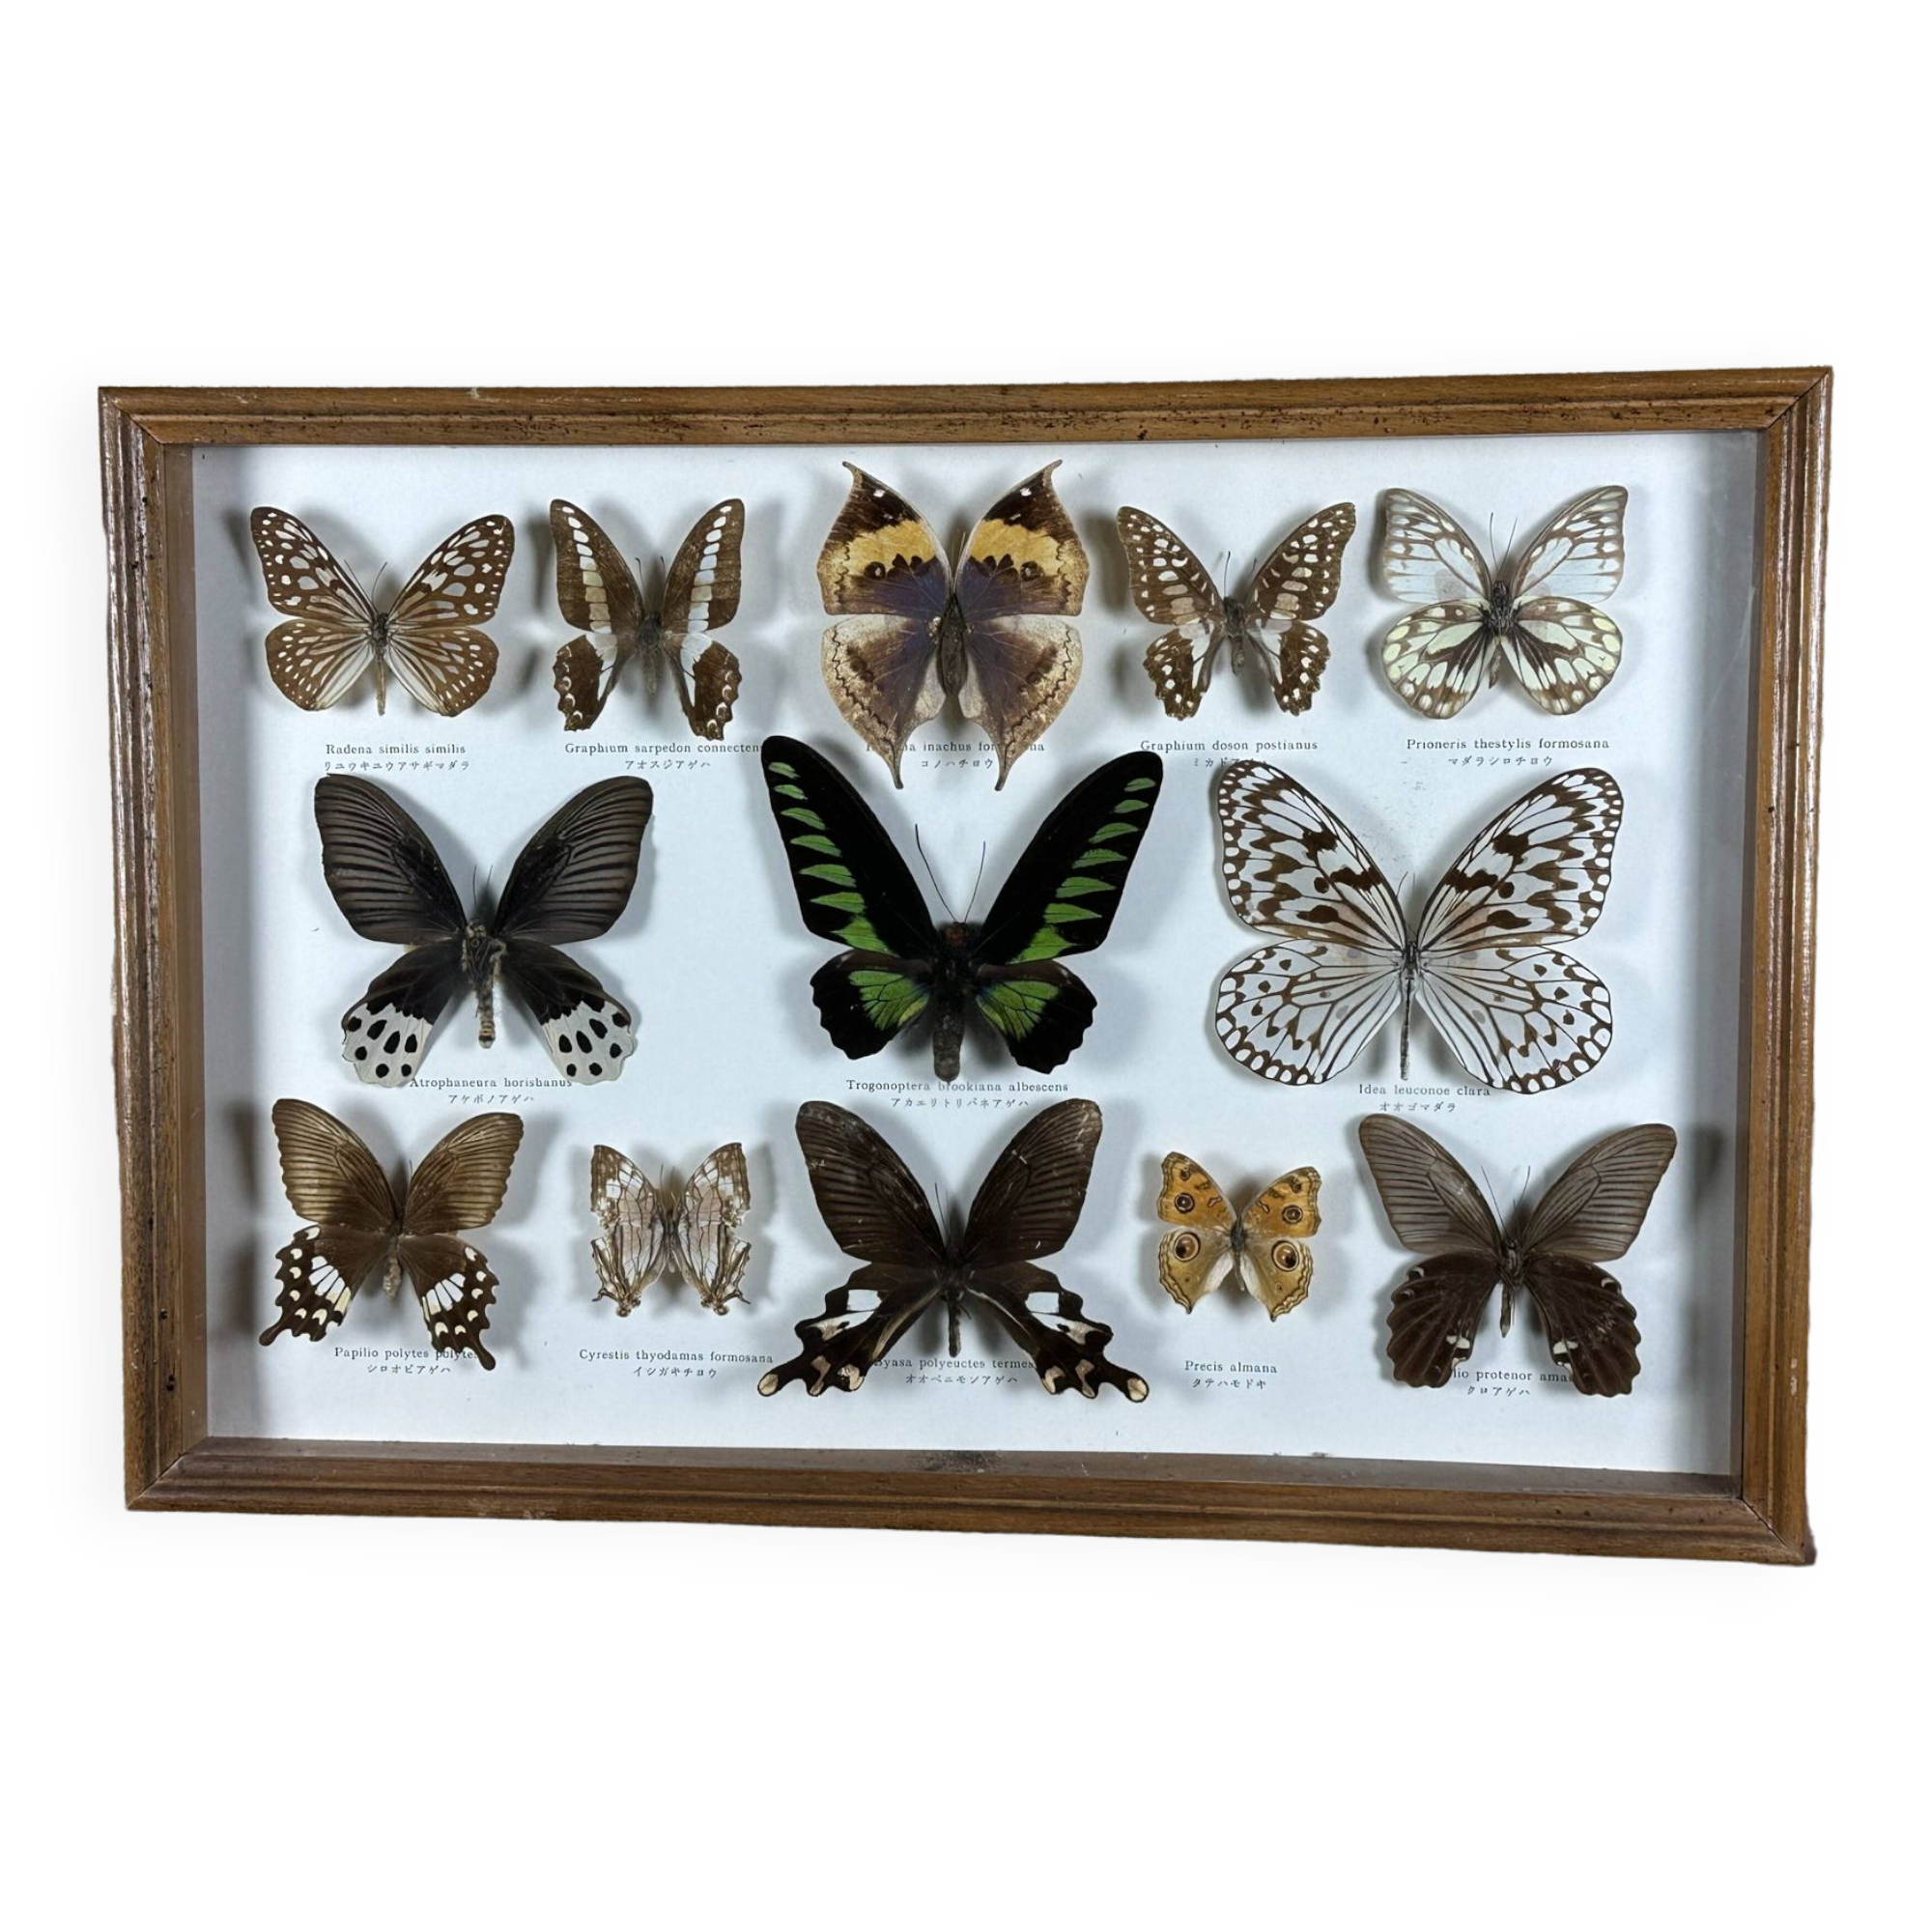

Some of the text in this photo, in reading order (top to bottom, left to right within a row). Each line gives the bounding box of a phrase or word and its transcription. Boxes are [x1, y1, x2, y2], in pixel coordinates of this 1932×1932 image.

[326, 744, 466, 754] Radena similis similis
[565, 743, 762, 756] Graphium sarpedon connecten
[923, 742, 972, 752] inachus
[1141, 740, 1318, 753] Graphium doson postianus
[1406, 738, 1609, 751] Prioneris thestylis formosana
[846, 1079, 1068, 1093] Trogonoptera brookiana albescens
[1359, 1084, 1491, 1095] Idea leuconoe clara
[335, 1347, 379, 1359] Papilio
[384, 1348, 429, 1360] polytes
[580, 1349, 773, 1363] Cyrestis thyodamas formosana
[1184, 1360, 1277, 1373] Precis almana
[1477, 1370, 1532, 1381] protenor
